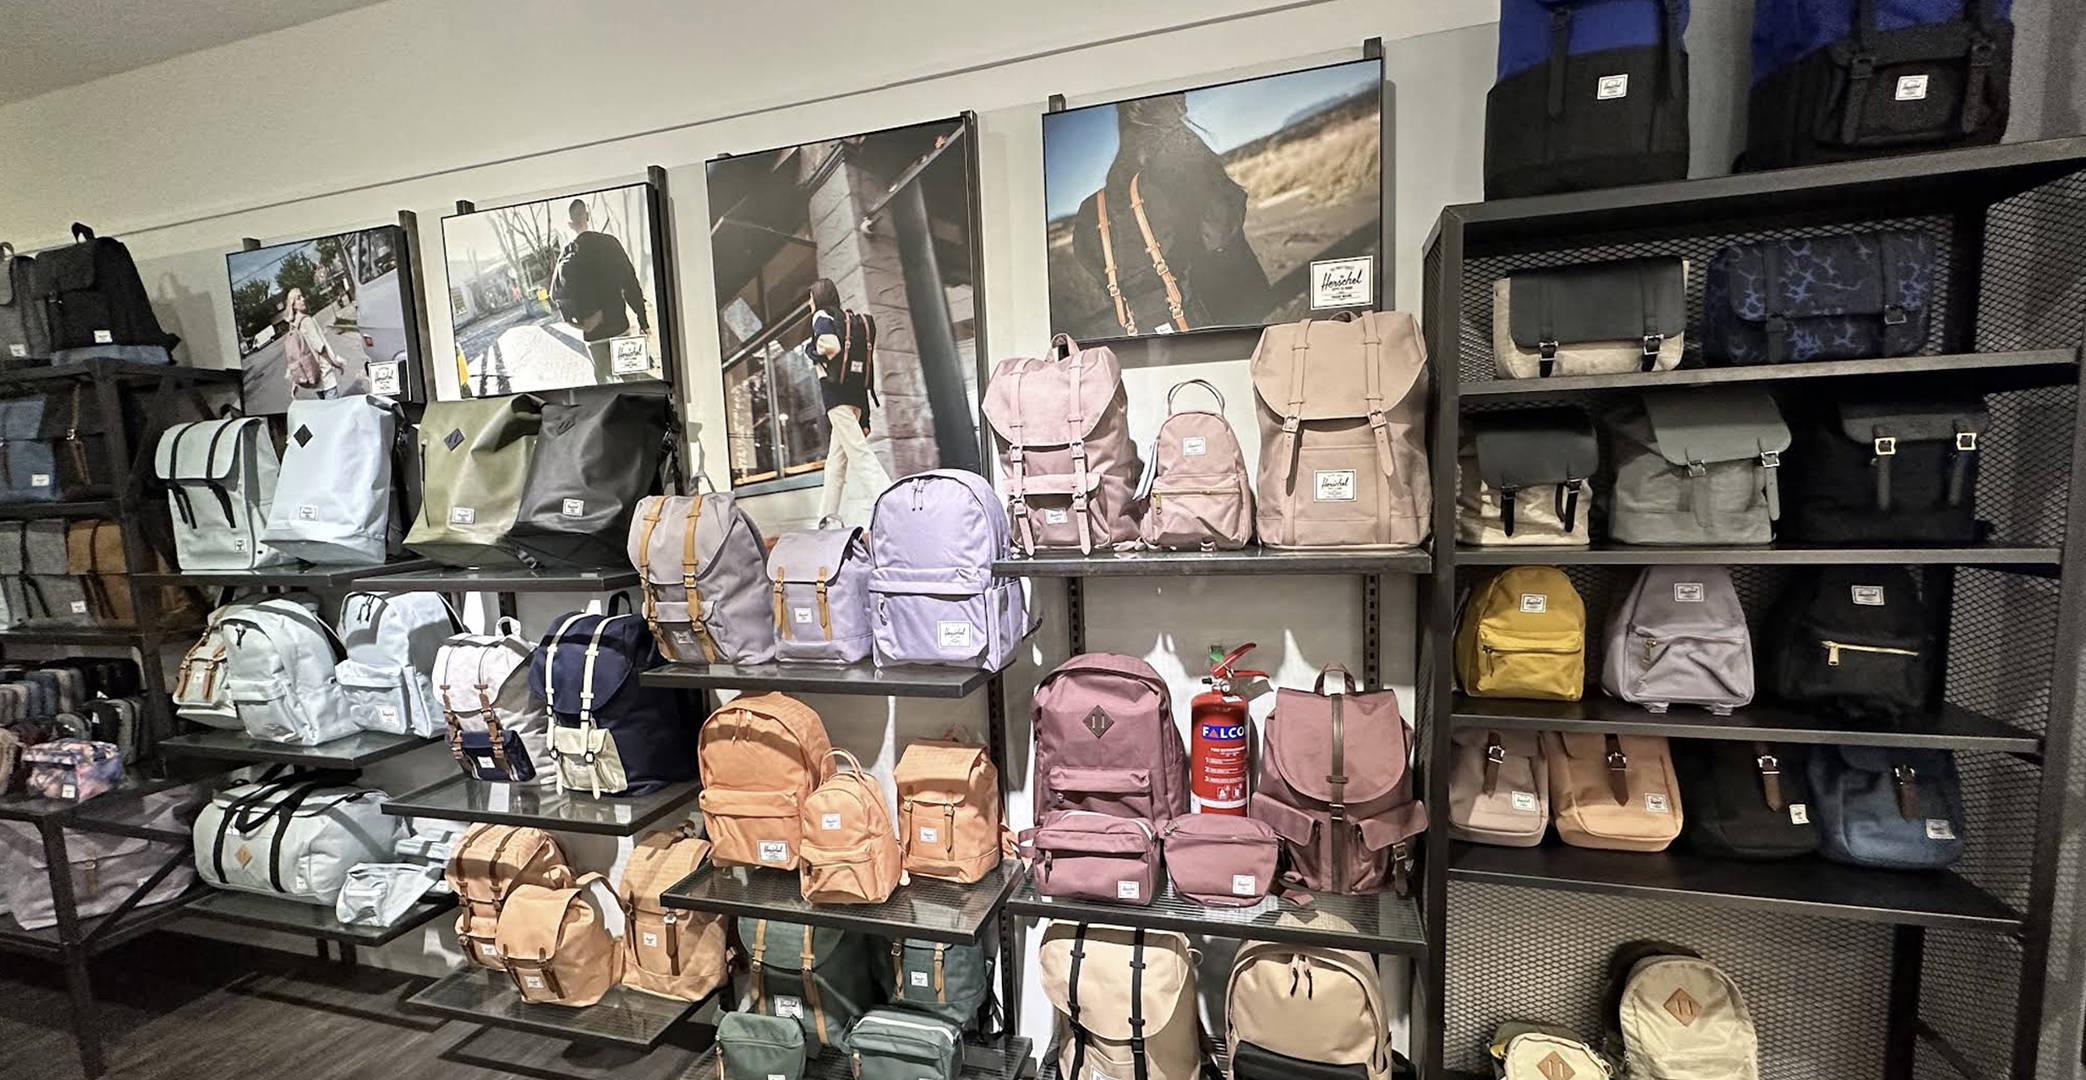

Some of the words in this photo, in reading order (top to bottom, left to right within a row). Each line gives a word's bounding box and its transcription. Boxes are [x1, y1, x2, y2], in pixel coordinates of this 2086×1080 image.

[1321, 268, 1362, 291] Herschel
[617, 344, 642, 361] Herschel
[1321, 476, 1349, 490] Herschel
[1203, 726, 1244, 738] FALCO
